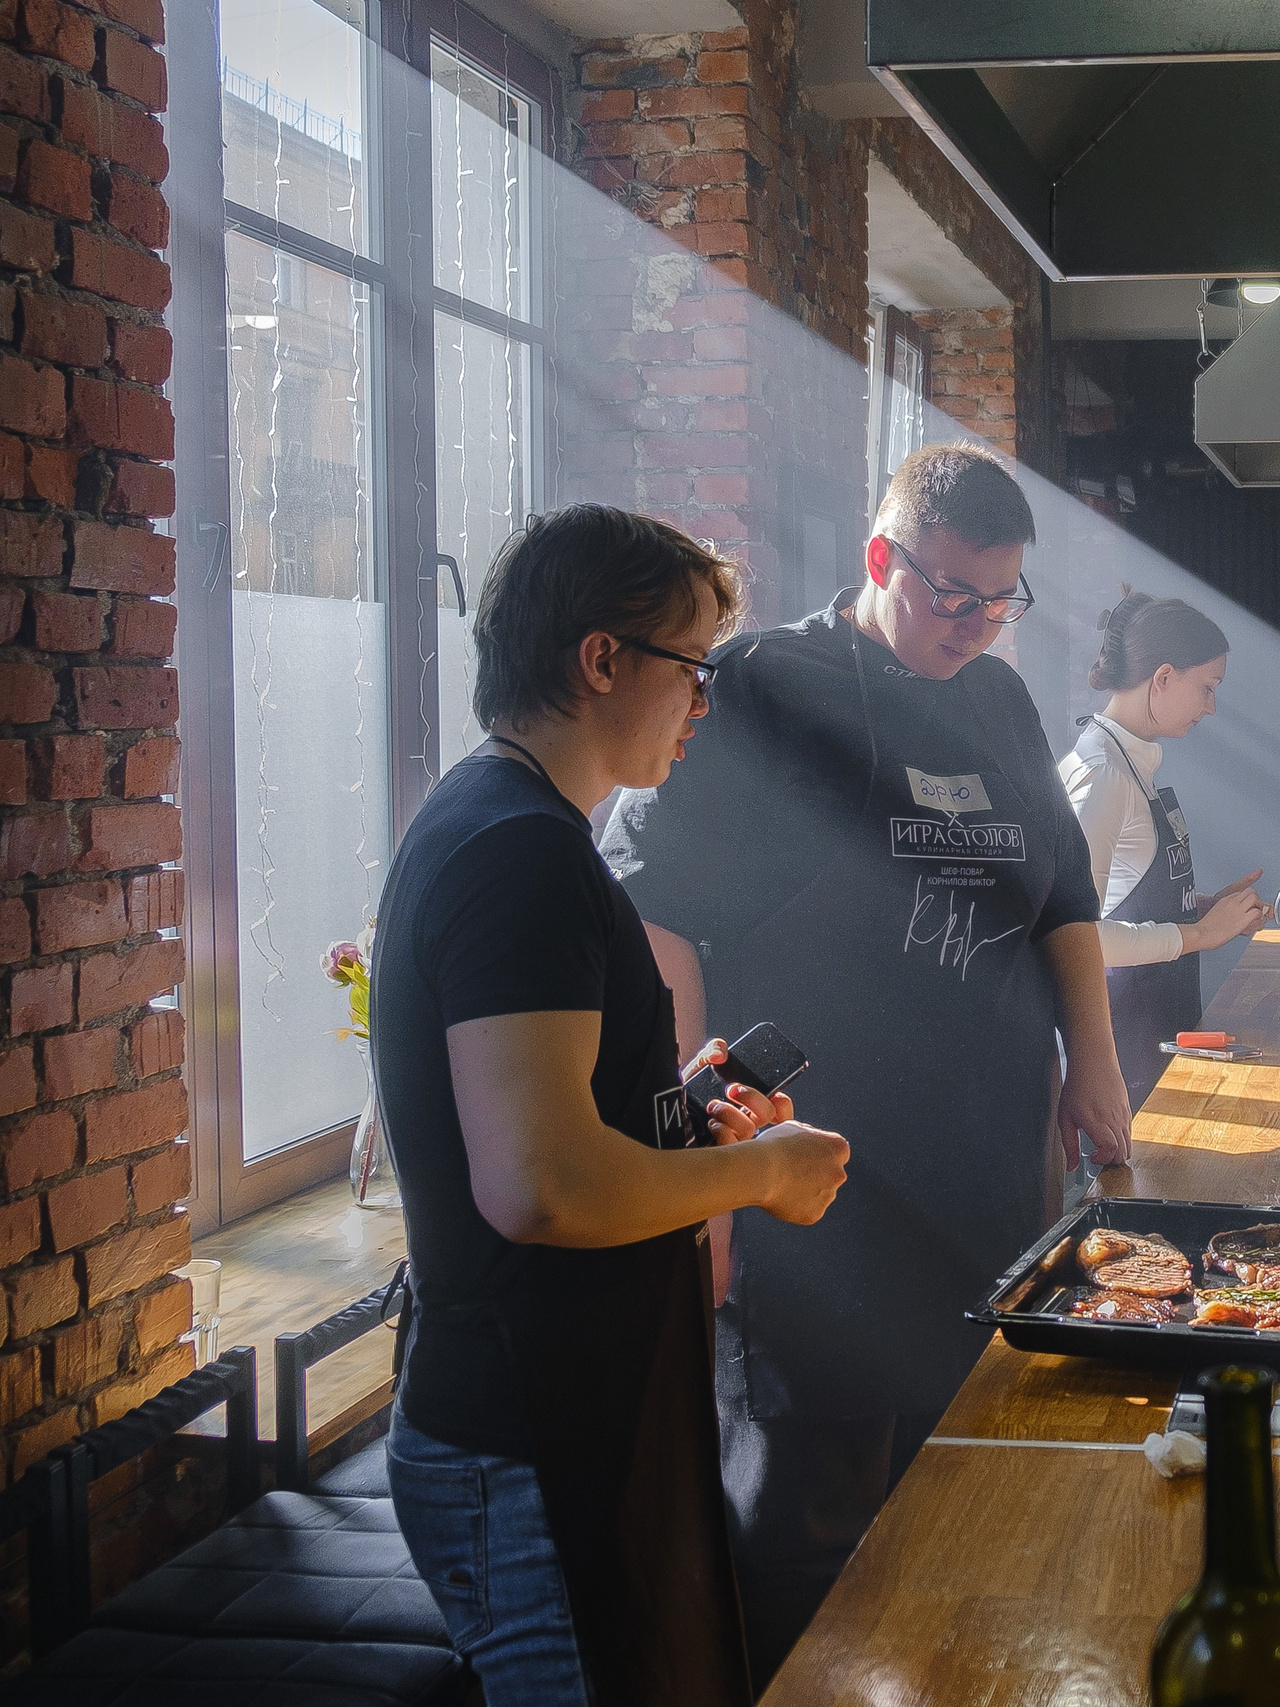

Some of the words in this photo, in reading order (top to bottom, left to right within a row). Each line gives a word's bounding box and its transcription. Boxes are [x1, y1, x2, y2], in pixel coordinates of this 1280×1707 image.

[897, 823, 947, 845] ИГРА
[947, 828, 1020, 848] СТОЛОВ
[916, 846, 971, 855] КУЛИНАРНАЯ
[941, 866, 985, 876] ШЕФ-ПОВАР
[927, 877, 967, 886] КОРНИЛОВ
[968, 878, 996, 887] ВИКТОР
